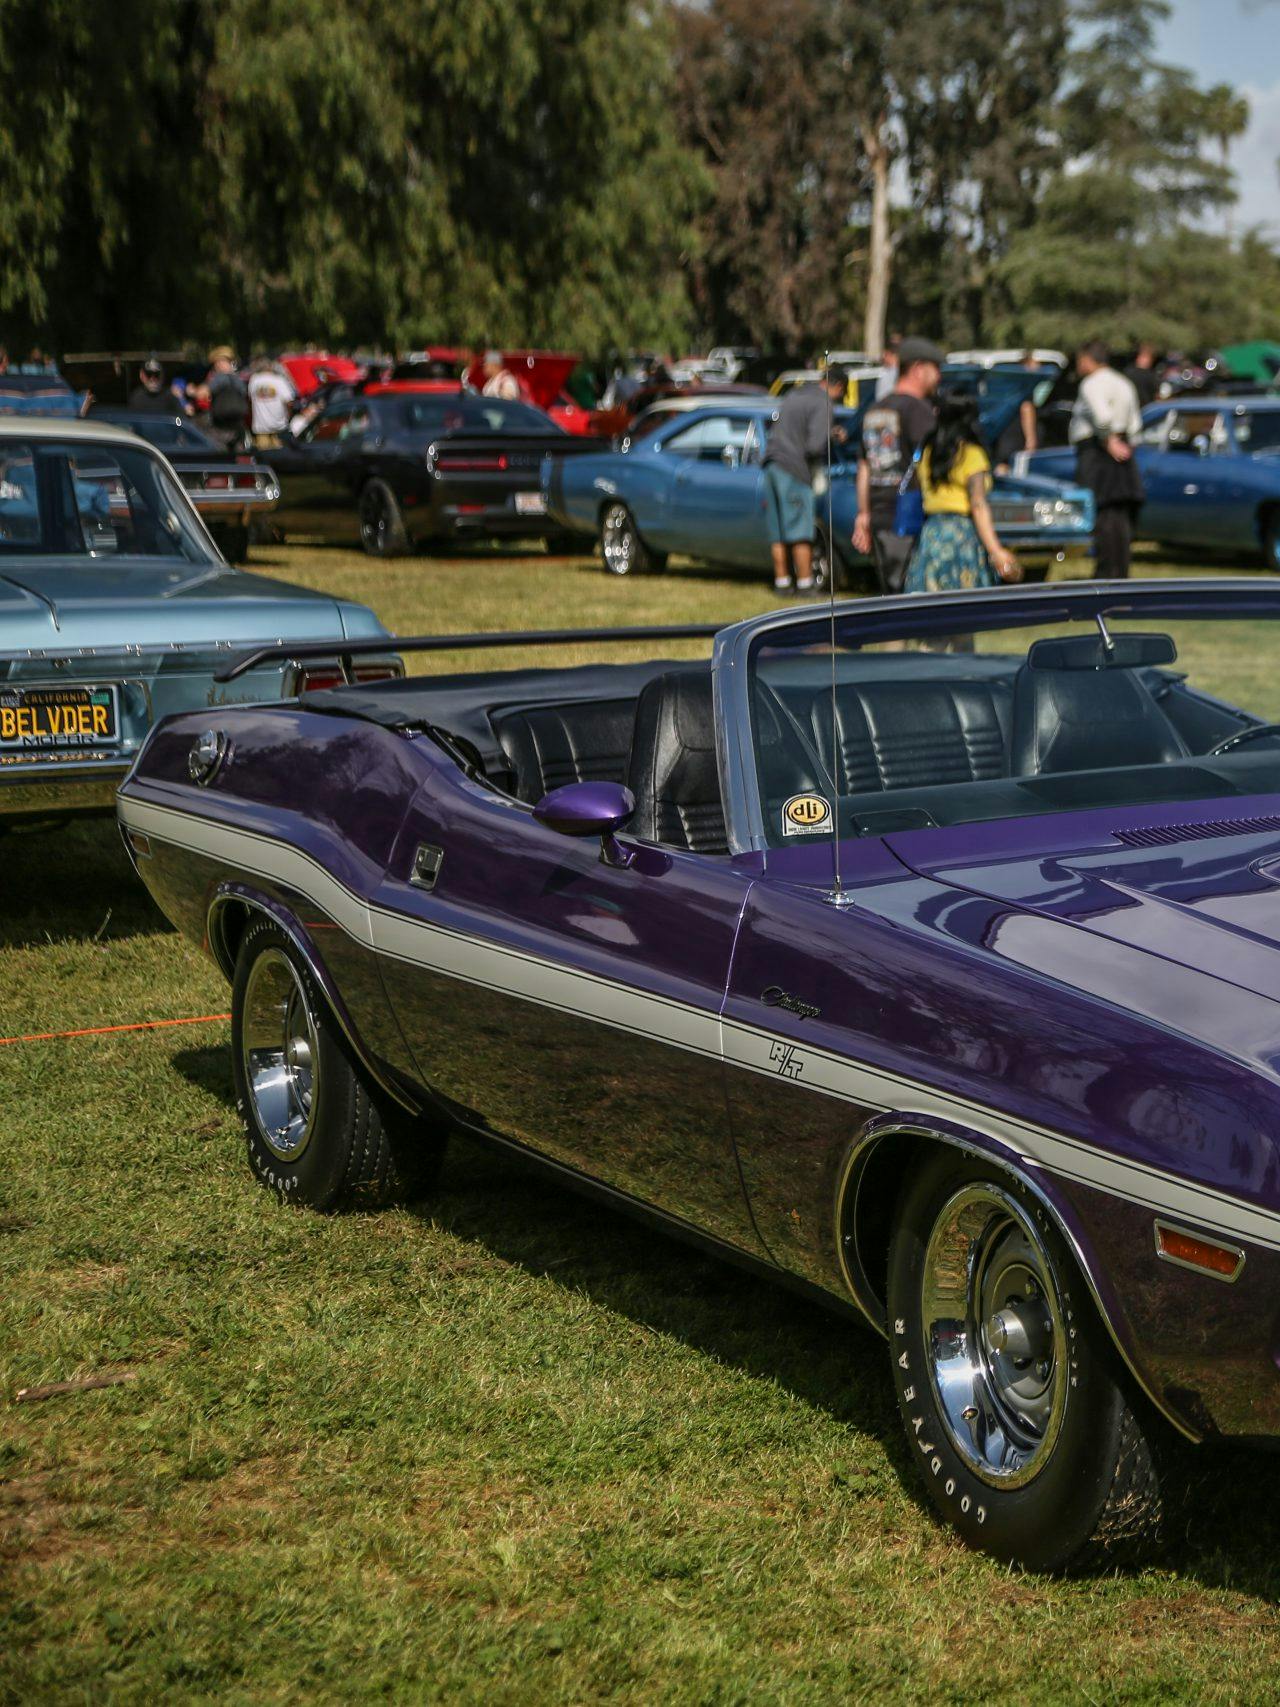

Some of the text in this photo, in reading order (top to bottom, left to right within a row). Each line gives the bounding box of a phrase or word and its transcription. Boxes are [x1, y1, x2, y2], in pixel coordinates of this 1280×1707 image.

[24, 689, 88, 704] CALIFORNIA
[0, 704, 108, 738] BELVDER
[769, 1040, 804, 1080] R/T
[893, 1316, 988, 1526] GOODYEAR
